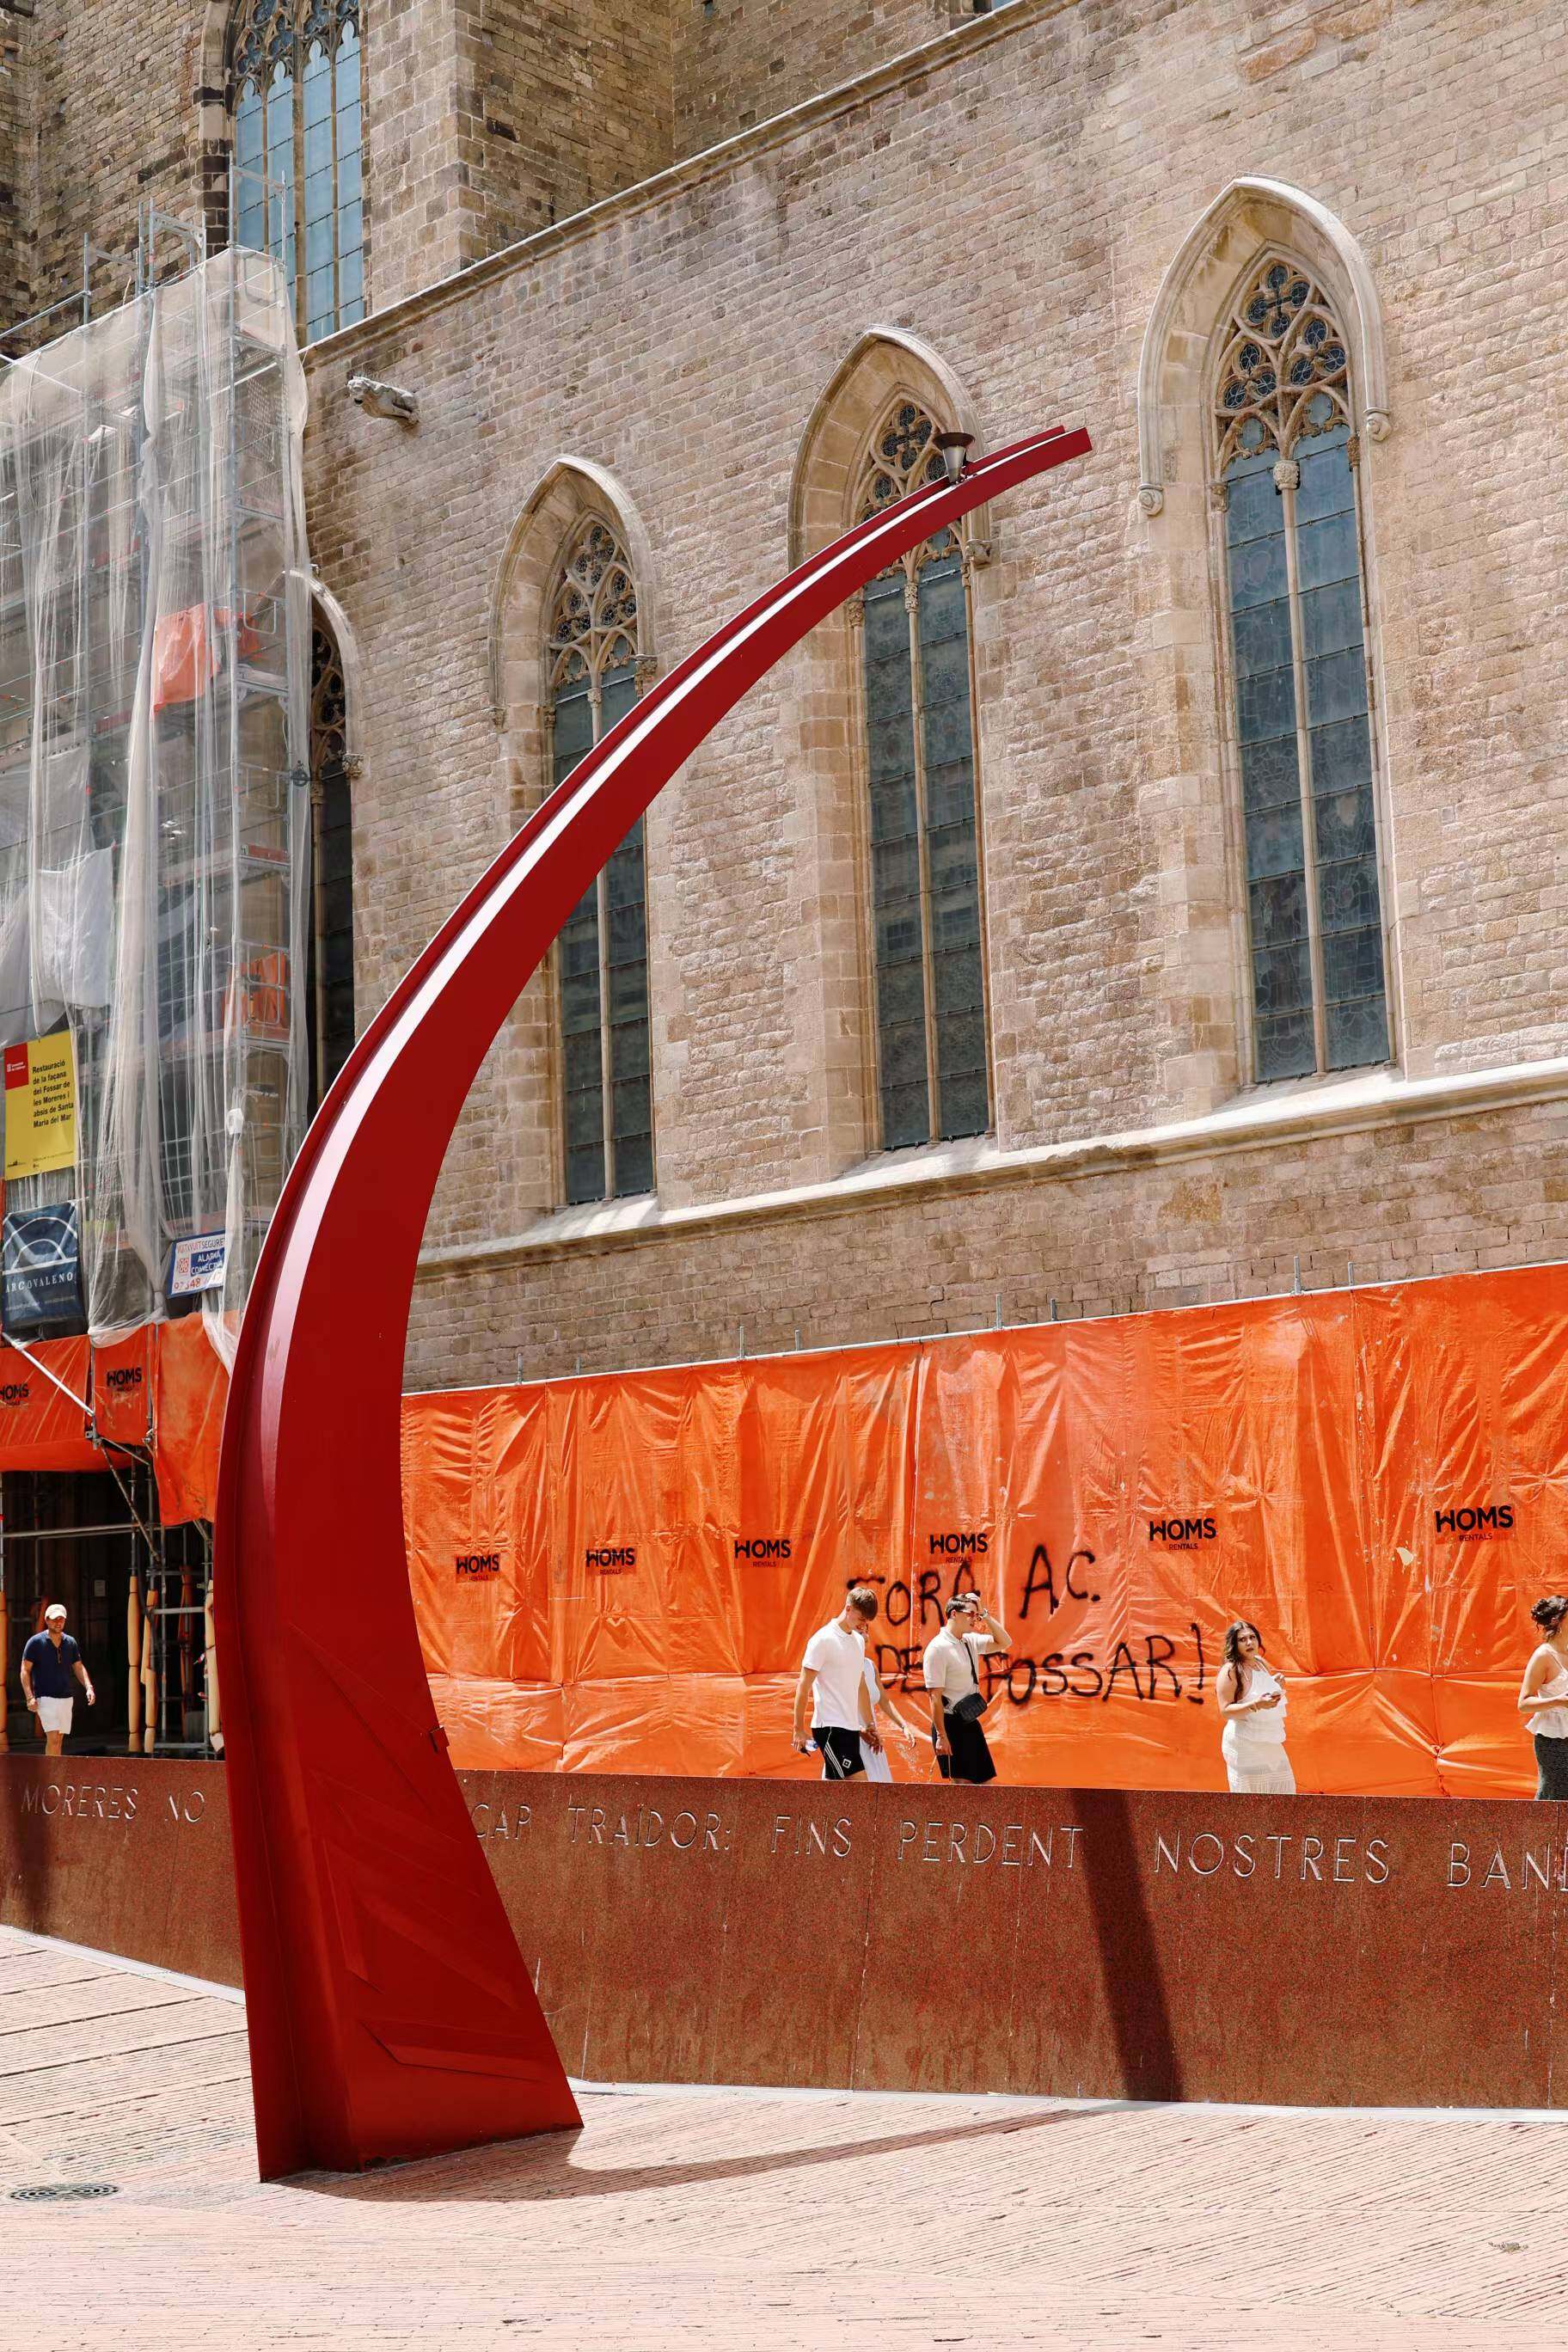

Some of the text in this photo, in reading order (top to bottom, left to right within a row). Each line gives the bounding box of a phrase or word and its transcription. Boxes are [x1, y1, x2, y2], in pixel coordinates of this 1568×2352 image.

[32, 1059, 66, 1074] Restauració
[33, 1076, 40, 1085] de
[47, 1070, 67, 1082] façana
[33, 1080, 70, 1096] del Fossar de
[33, 1098, 42, 1106] les
[43, 1093, 66, 1105] Moreres
[33, 1102, 74, 1118] absis de Santa
[50, 1114, 59, 1124] del
[60, 1113, 72, 1122] Mar
[5, 1271, 74, 1293] ARCOVALENO
[107, 1367, 142, 1387] HOMS
[1434, 1504, 1514, 1533] HOMS
[1148, 1517, 1217, 1541] HOMS
[1458, 1533, 1493, 1542] RENTALS
[734, 1539, 791, 1559] HOMS
[929, 1532, 989, 1554] HOMS
[1168, 1542, 1198, 1551] RENTALS
[456, 1553, 499, 1575] HOMS
[585, 1547, 635, 1568] HOMS
[979, 1623, 1204, 1706] FOSSAR!
[20, 1782, 138, 1820] MORERES
[164, 1791, 205, 1822] NO
[470, 1803, 532, 1840] CAP
[771, 1815, 853, 1858] FINS
[897, 1820, 1084, 1869] PERDENT
[1153, 1829, 1390, 1884] NOSTRES
